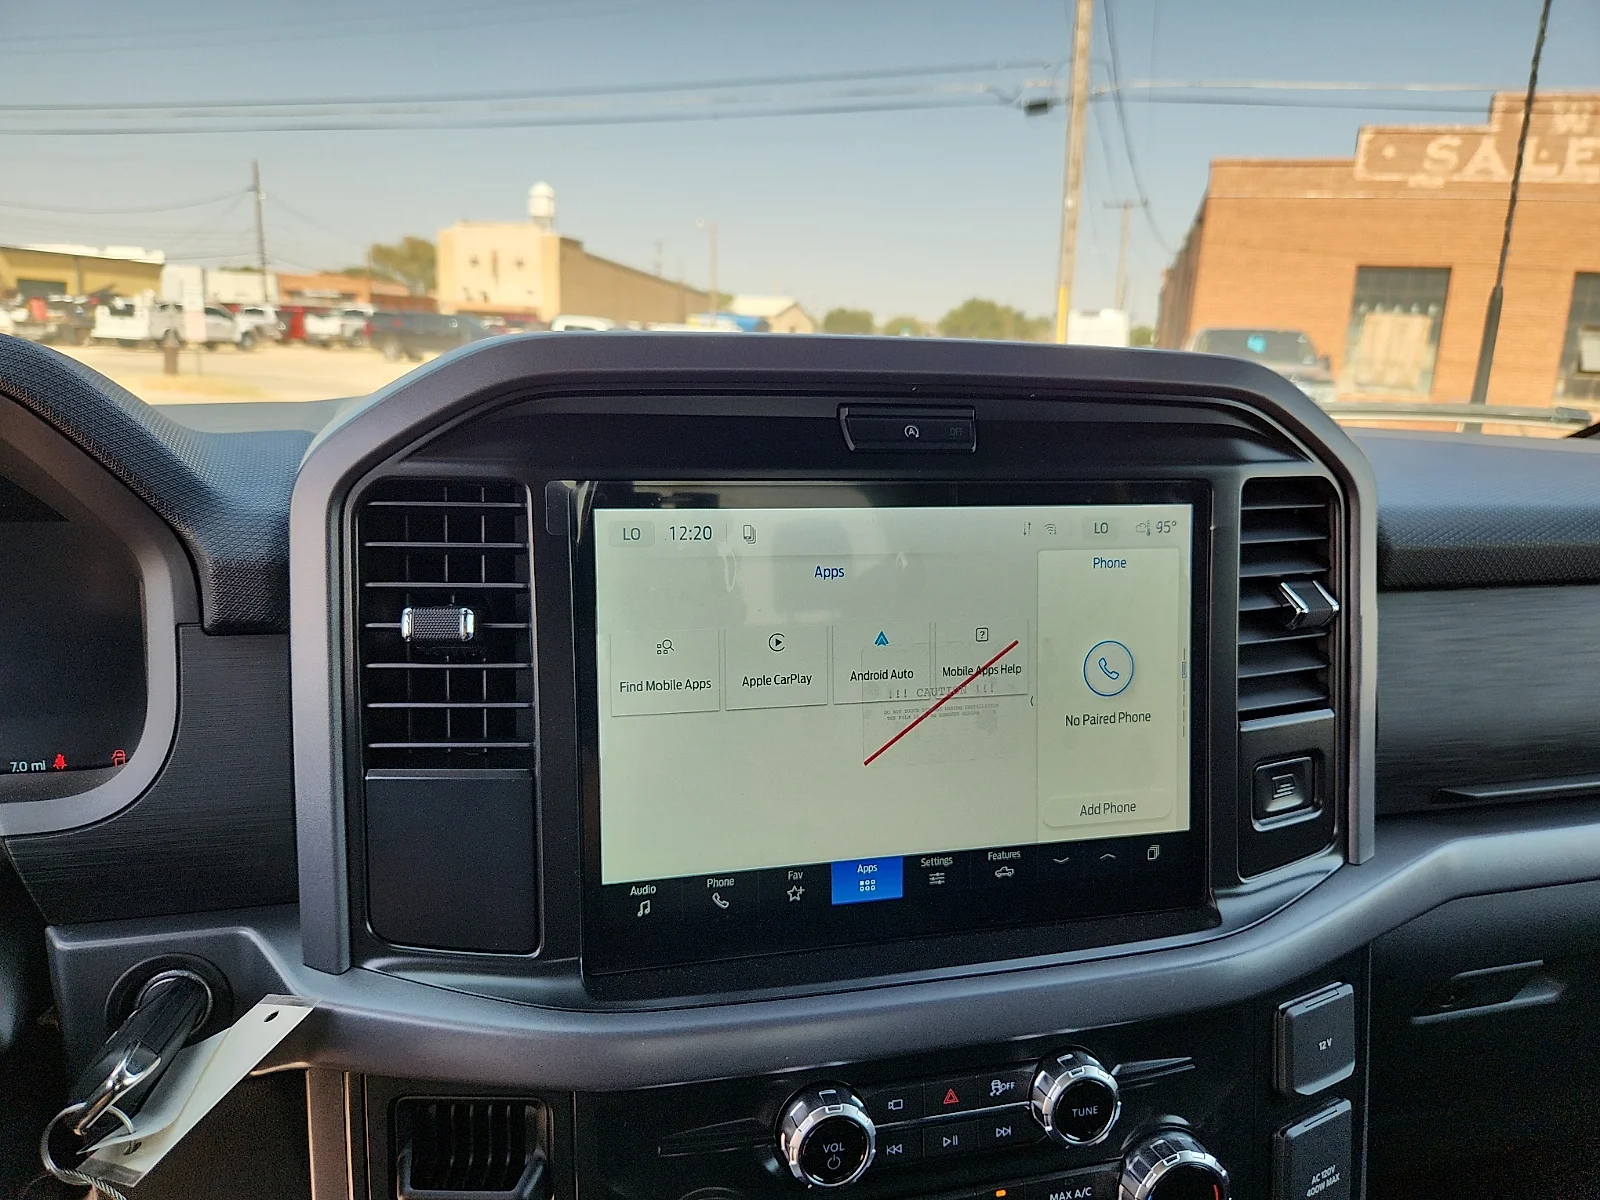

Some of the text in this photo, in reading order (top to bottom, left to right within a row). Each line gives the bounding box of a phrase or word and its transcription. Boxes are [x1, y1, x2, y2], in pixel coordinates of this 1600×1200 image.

[622, 527, 641, 541] LO
[669, 525, 713, 541] 12:20
[1094, 522, 1109, 534] LO
[1092, 556, 1127, 570] Phone
[814, 565, 845, 580] Apps
[850, 668, 914, 682] Android Auto
[942, 665, 974, 677] Mobile
[1000, 664, 1022, 675] Help
[619, 678, 712, 693] Find Mobile Apps
[741, 674, 812, 688] Apple CarPlay
[1065, 711, 1151, 727] No Paired Phone
[9, 760, 46, 773] 7.0 mi
[1080, 801, 1137, 816] Add Phone
[920, 855, 953, 868] Settings
[987, 849, 1021, 861] Features
[787, 870, 804, 881] Fav
[857, 862, 878, 876] Apps
[706, 876, 735, 889] Phone
[630, 884, 657, 897] Audio
[1001, 1081, 1016, 1091] OFF
[1072, 1105, 1099, 1118] TUNE
[822, 1141, 846, 1154] VOL
[1049, 1186, 1092, 1200] MAX A/C
